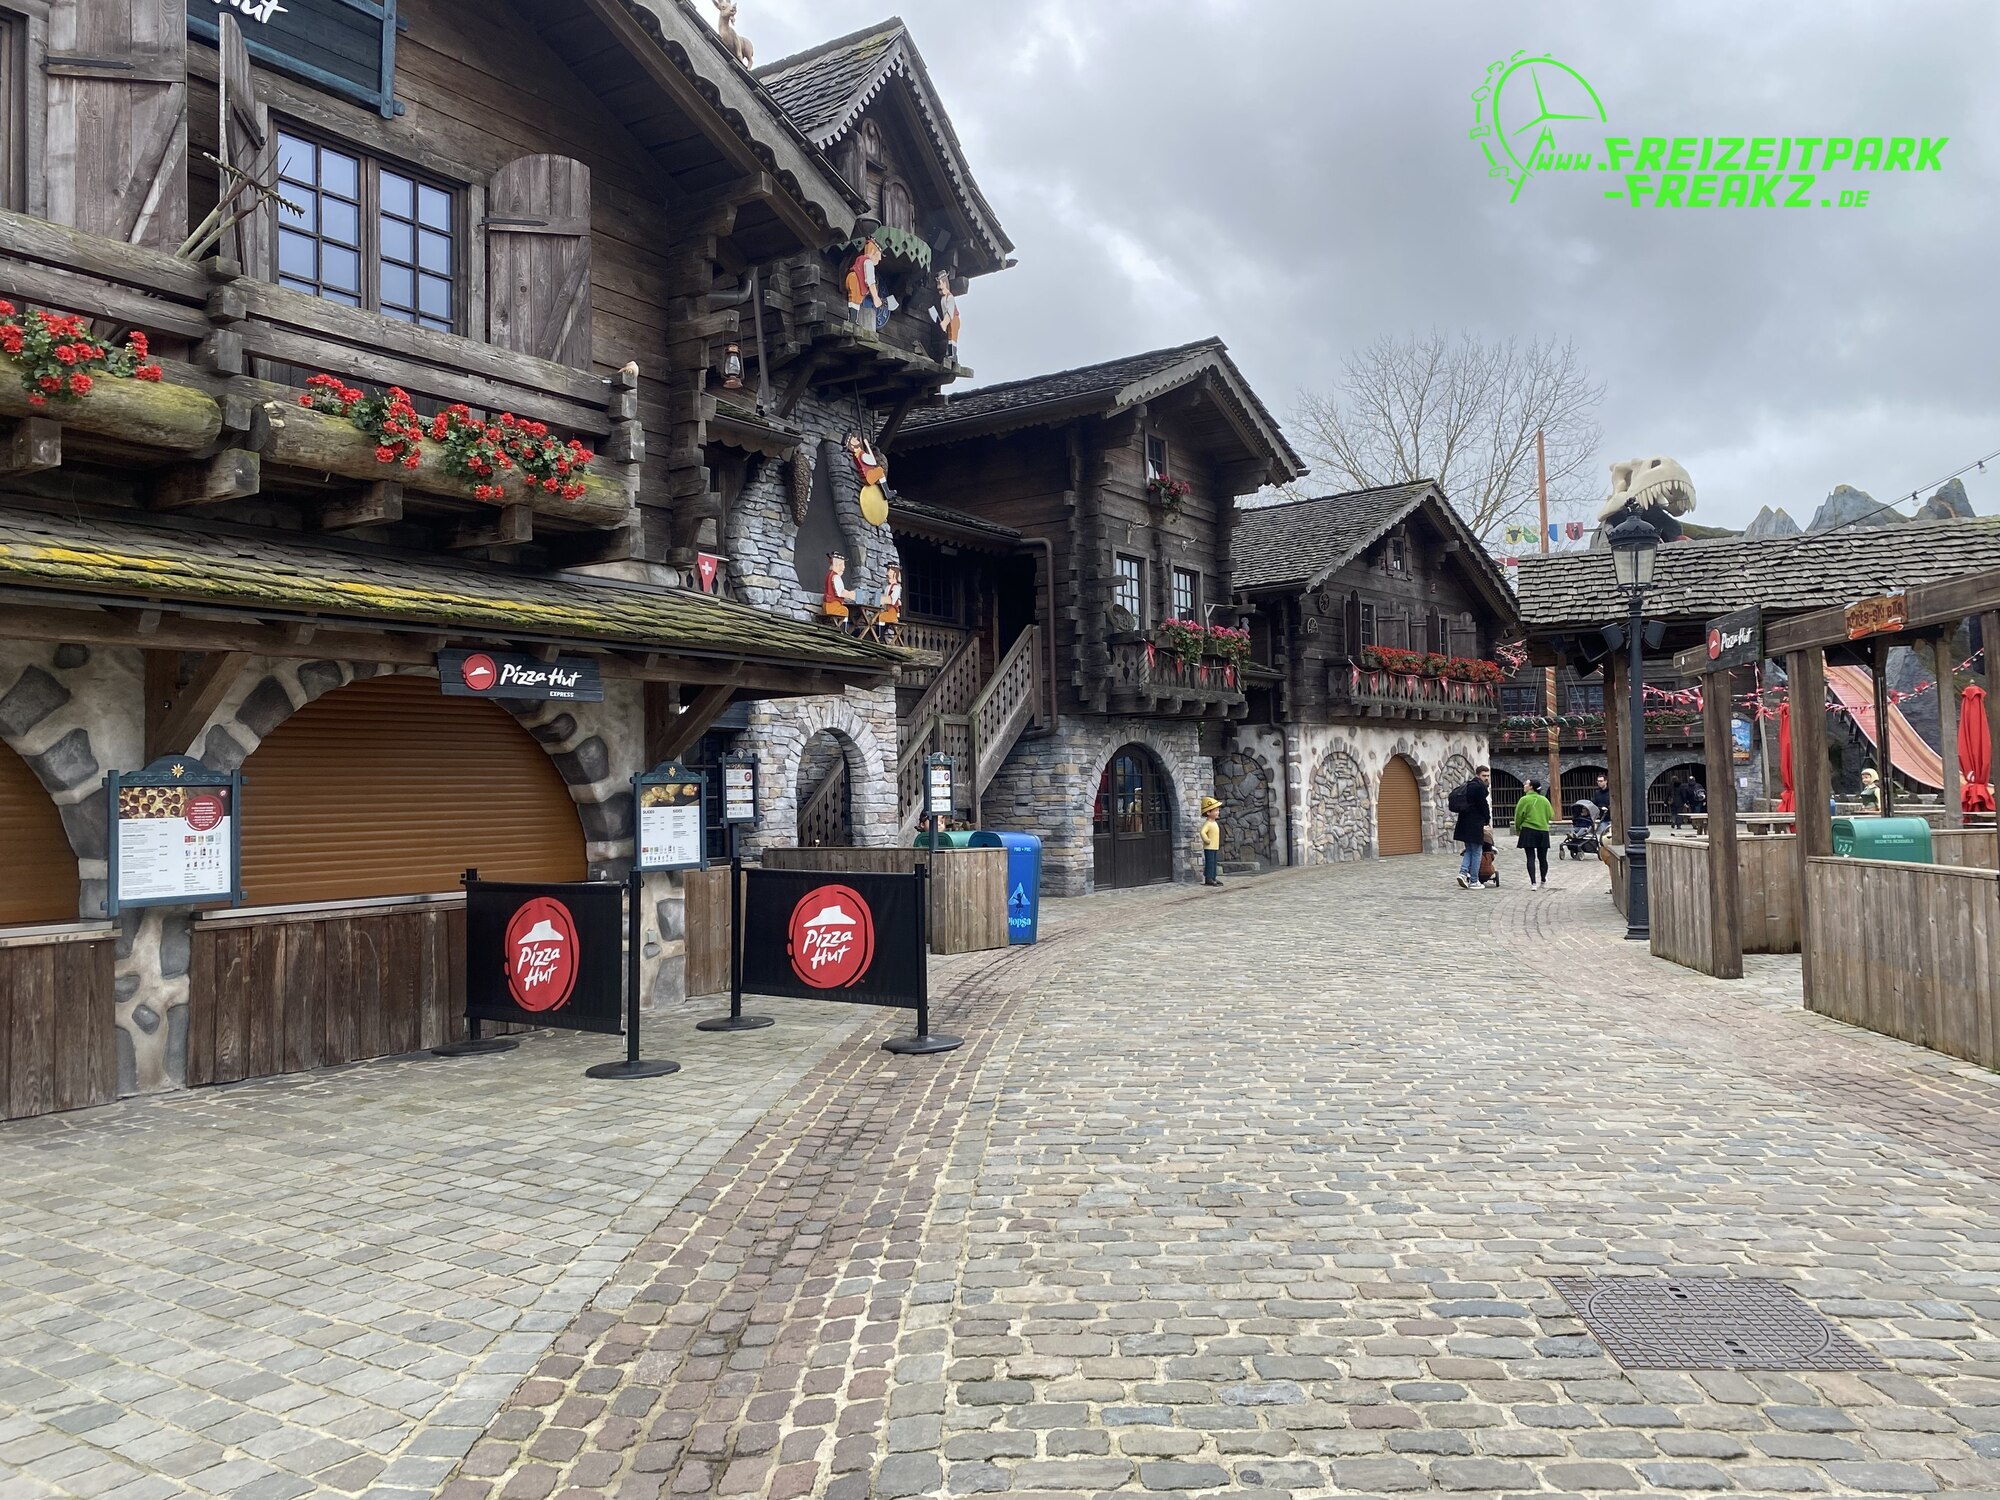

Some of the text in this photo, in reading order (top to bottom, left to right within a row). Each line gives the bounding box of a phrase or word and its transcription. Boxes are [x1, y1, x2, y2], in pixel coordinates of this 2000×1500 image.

[211, 0, 288, 24] ut
[499, 663, 582, 687] Pizza Hut
[549, 690, 574, 698] EXPRESS
[802, 925, 854, 954] Pizza
[517, 942, 561, 974] Pizza
[810, 944, 851, 970] Hut
[524, 963, 558, 991] Hut
